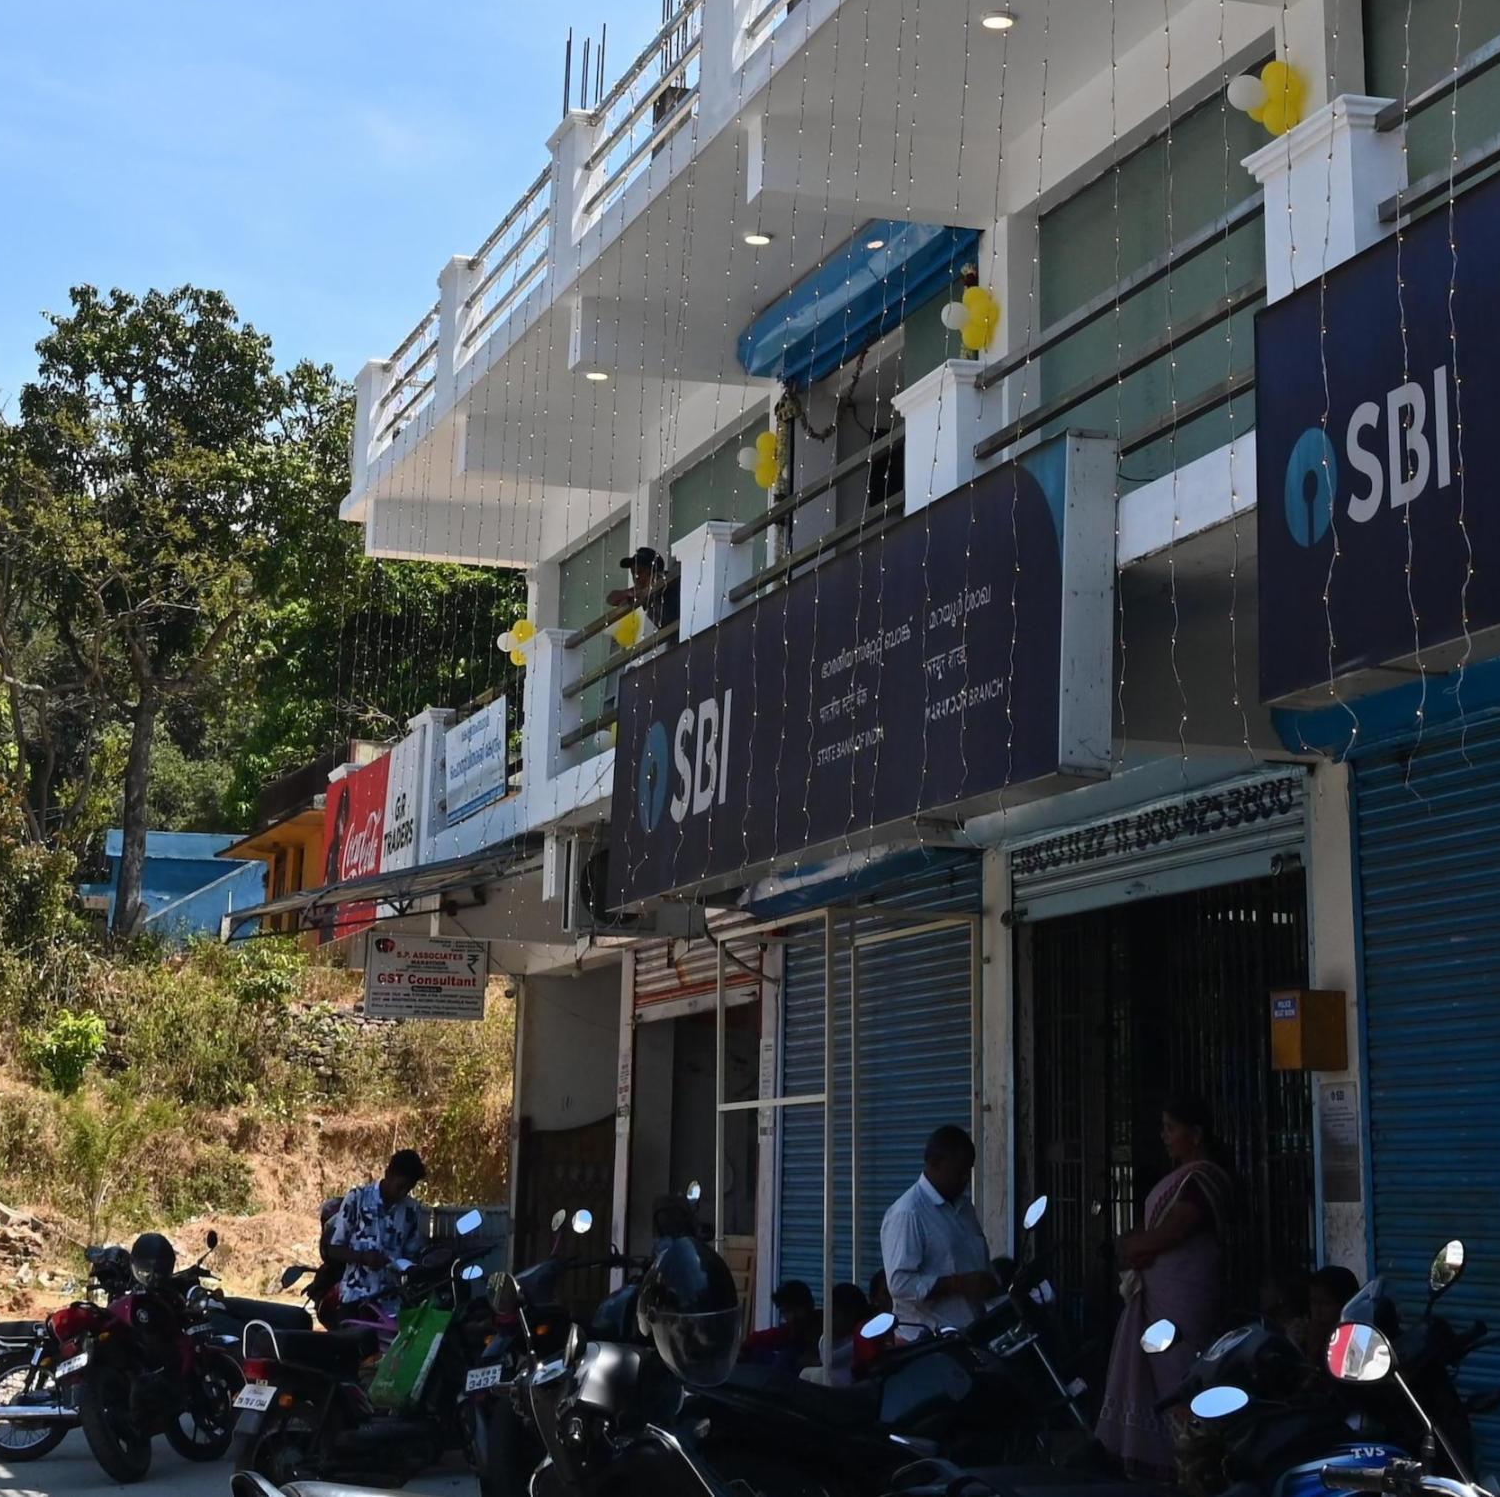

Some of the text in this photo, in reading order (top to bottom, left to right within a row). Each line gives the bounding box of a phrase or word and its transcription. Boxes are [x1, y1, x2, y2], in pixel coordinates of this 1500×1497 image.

[1346, 365, 1452, 525] SBI
[968, 677, 1004, 708] BRANCH
[670, 689, 732, 824] SBI
[383, 818, 414, 858] TRADERS
[412, 951, 464, 961] ASSOCIATES
[377, 973, 477, 987] GST Consultant
[1350, 1446, 1386, 1459] TVS
